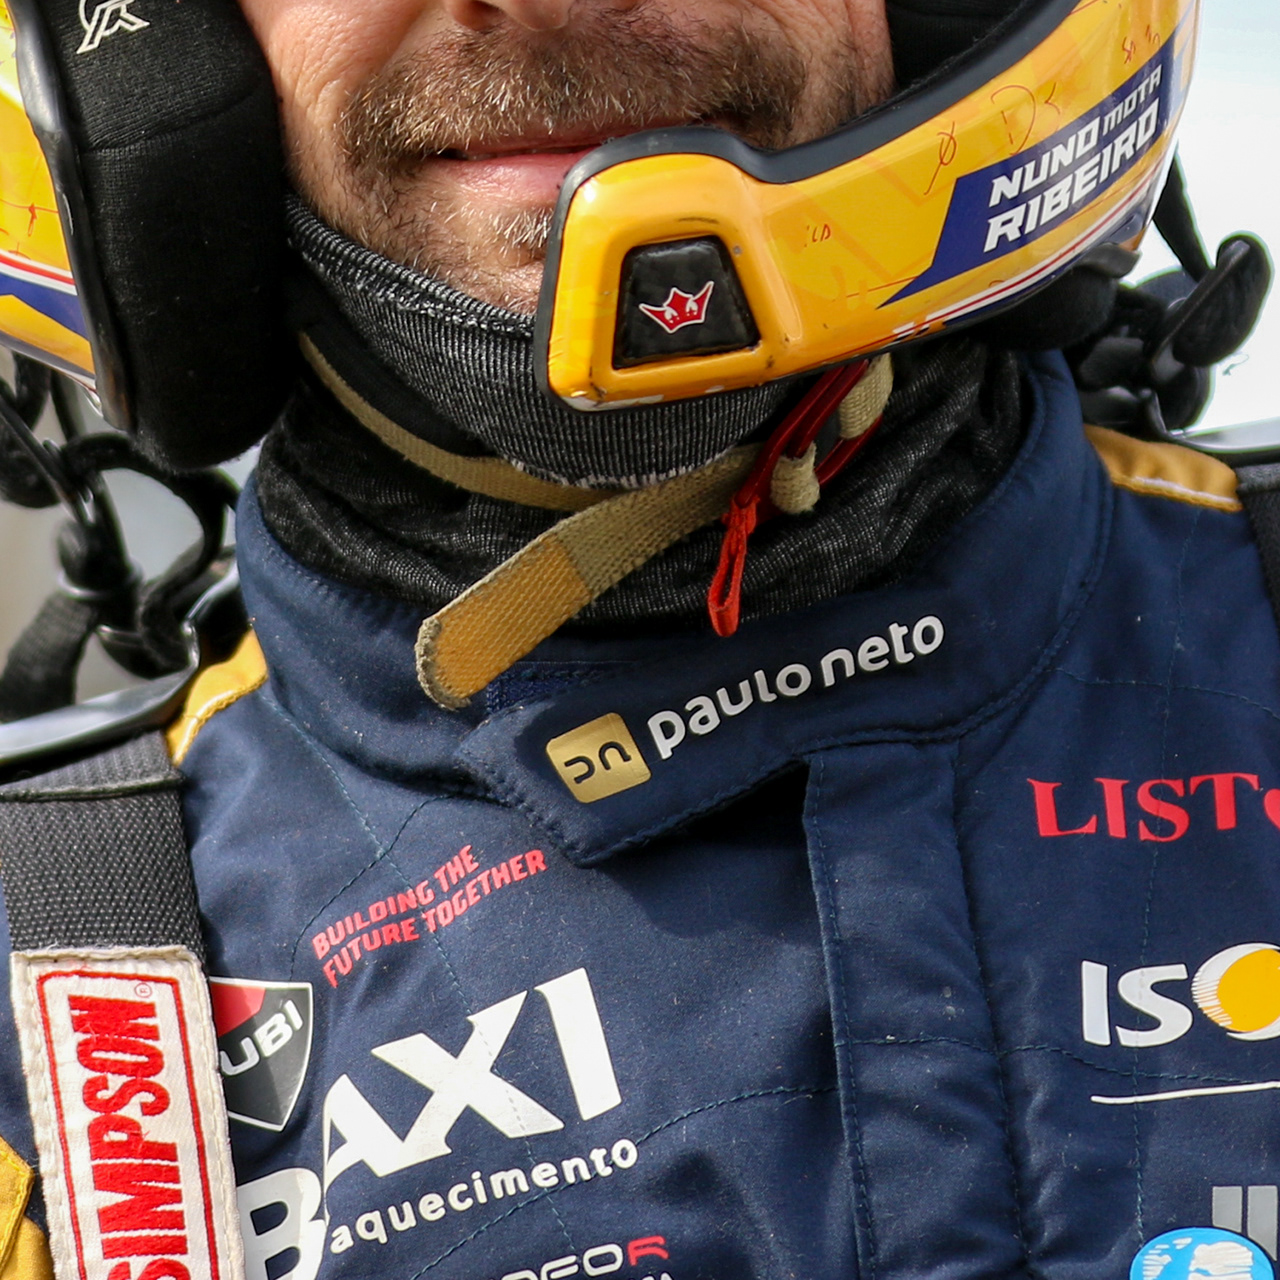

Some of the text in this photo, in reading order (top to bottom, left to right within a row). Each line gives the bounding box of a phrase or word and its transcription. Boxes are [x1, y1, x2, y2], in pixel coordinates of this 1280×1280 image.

[983, 97, 1160, 253] RIBEIRO
[988, 116, 1100, 208] NUNO
[647, 615, 946, 760] paulo neto
[312, 844, 480, 961] BUILDING THE
[322, 849, 547, 989] FUTURE TOGETHER
[220, 999, 304, 1076] UBI
[328, 1137, 639, 1256] aquecimento
